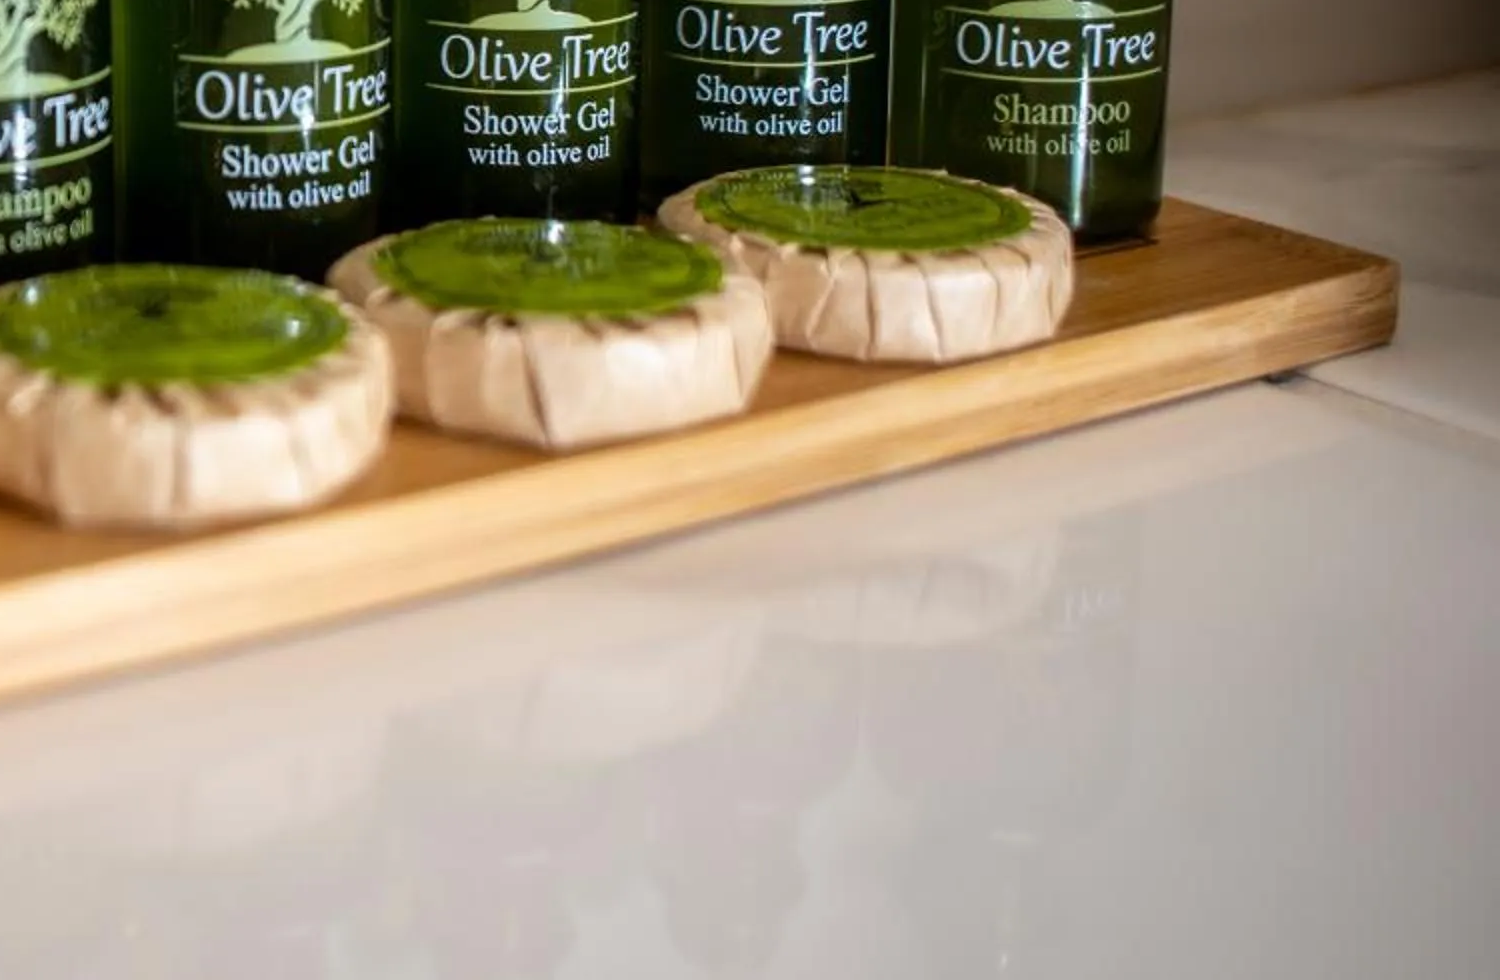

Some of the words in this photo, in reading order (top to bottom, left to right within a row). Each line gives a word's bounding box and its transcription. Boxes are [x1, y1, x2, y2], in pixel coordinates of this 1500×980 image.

[676, 5, 783, 55] Olive
[792, 11, 869, 54] Tree
[956, 20, 1072, 70] Olive
[1082, 23, 1156, 68] Tree
[440, 33, 552, 82] Olive
[562, 33, 631, 79] Tree
[195, 70, 314, 121] Olive
[323, 63, 388, 113] Tree
[695, 73, 801, 107] Shower
[807, 75, 851, 105] Gel
[993, 92, 1132, 132] Shampoo
[43, 93, 110, 147] Tree
[463, 104, 571, 136] Shower
[577, 96, 616, 132] Gel
[699, 111, 749, 136] with
[754, 113, 812, 136] olive
[817, 110, 844, 134] oil
[221, 144, 333, 178] Shower
[339, 129, 376, 169] Gel
[467, 142, 521, 166] with
[526, 141, 582, 166] olive
[587, 134, 611, 162] oil
[986, 130, 1038, 156] with
[1105, 127, 1132, 153] oil
[226, 182, 284, 210] with
[288, 180, 344, 208] olive
[348, 169, 372, 198] oil
[9, 219, 68, 254] olive
[70, 207, 94, 241] oil
